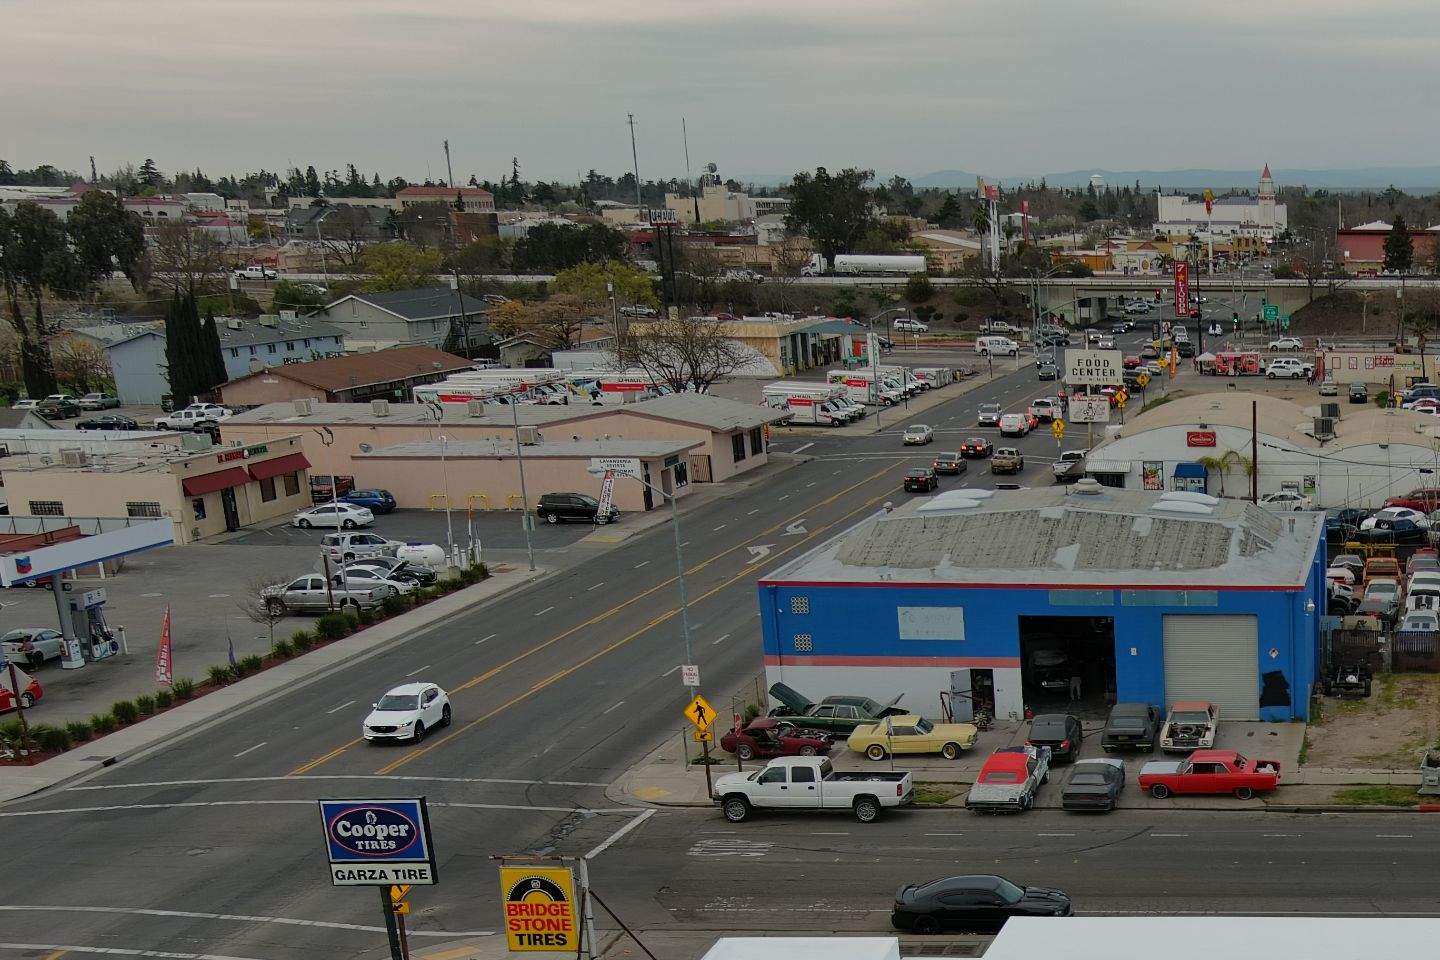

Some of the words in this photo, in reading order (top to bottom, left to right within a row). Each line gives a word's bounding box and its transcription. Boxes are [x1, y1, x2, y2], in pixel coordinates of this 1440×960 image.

[1077, 359, 1110, 367] FOOD
[1072, 368, 1116, 376] CENTER
[336, 820, 409, 840] Cooper
[355, 840, 397, 851] TIRES
[335, 869, 388, 881] GARZA
[391, 869, 429, 880] TIRE
[507, 903, 571, 917] BRIDGE
[509, 918, 572, 932] STONE
[515, 933, 568, 946] TIRES
